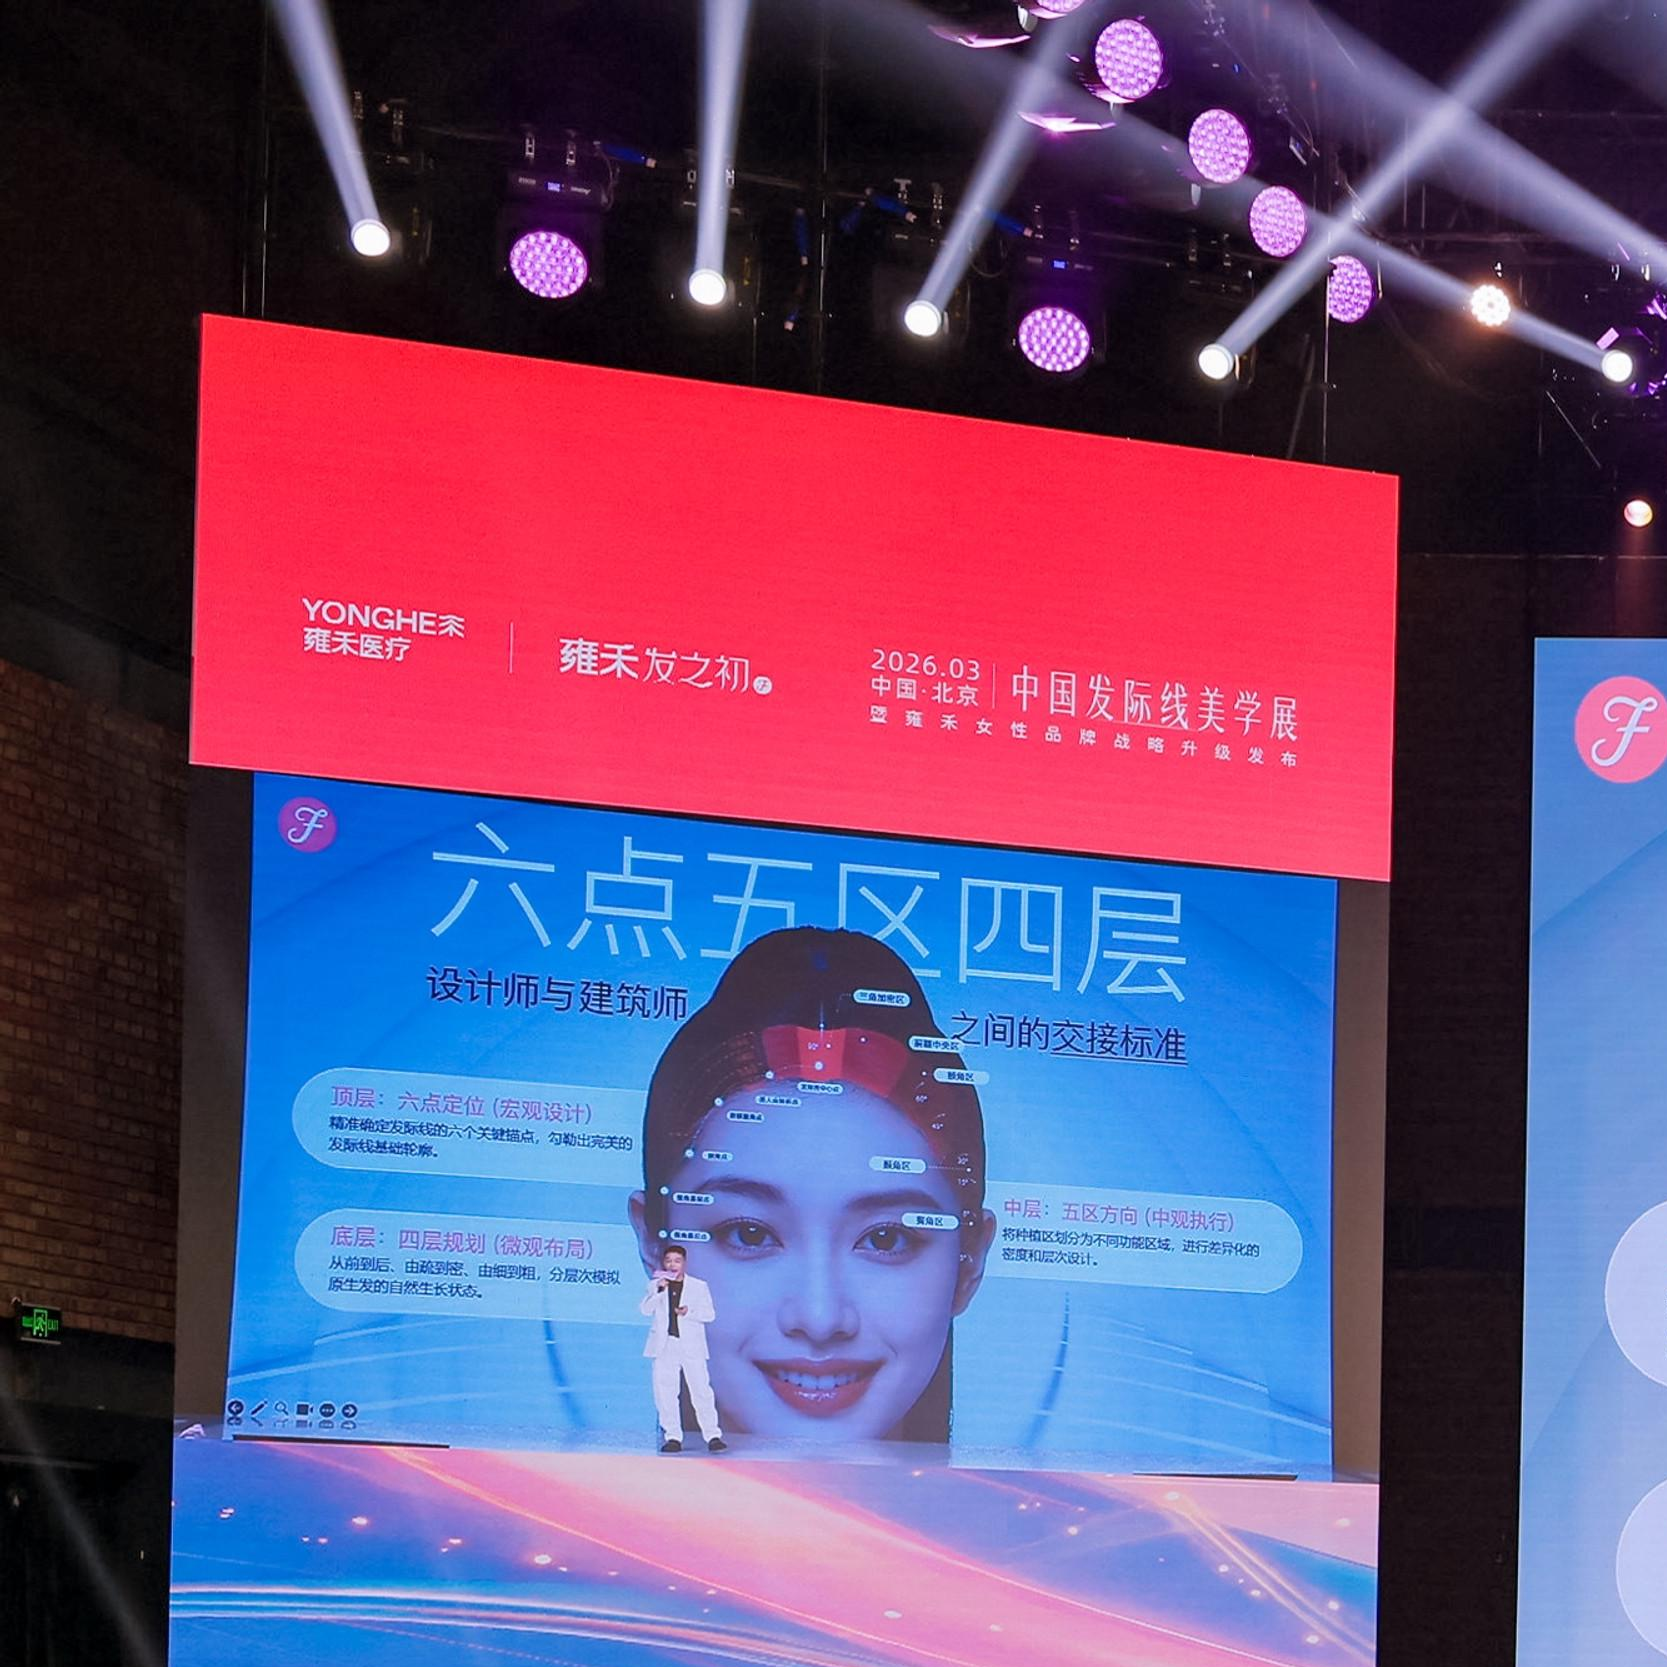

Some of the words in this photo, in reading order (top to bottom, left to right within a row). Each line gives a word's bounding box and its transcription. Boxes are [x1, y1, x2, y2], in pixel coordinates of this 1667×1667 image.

[302, 598, 437, 637] YONGHE
[303, 627, 411, 662] 雍禾医疗
[559, 637, 750, 693] 雍禾发之初
[870, 648, 981, 681] 2026.03
[870, 675, 980, 707] 中国·北京
[1011, 665, 1299, 742] 中国发际线美学展
[869, 706, 1298, 768] 暨雍禾女性品牌战略升级发布
[430, 822, 1187, 1004] 六点五区四层
[425, 966, 689, 1022] 设计师与建筑师
[950, 1011, 1187, 1063] 之间的交接标准
